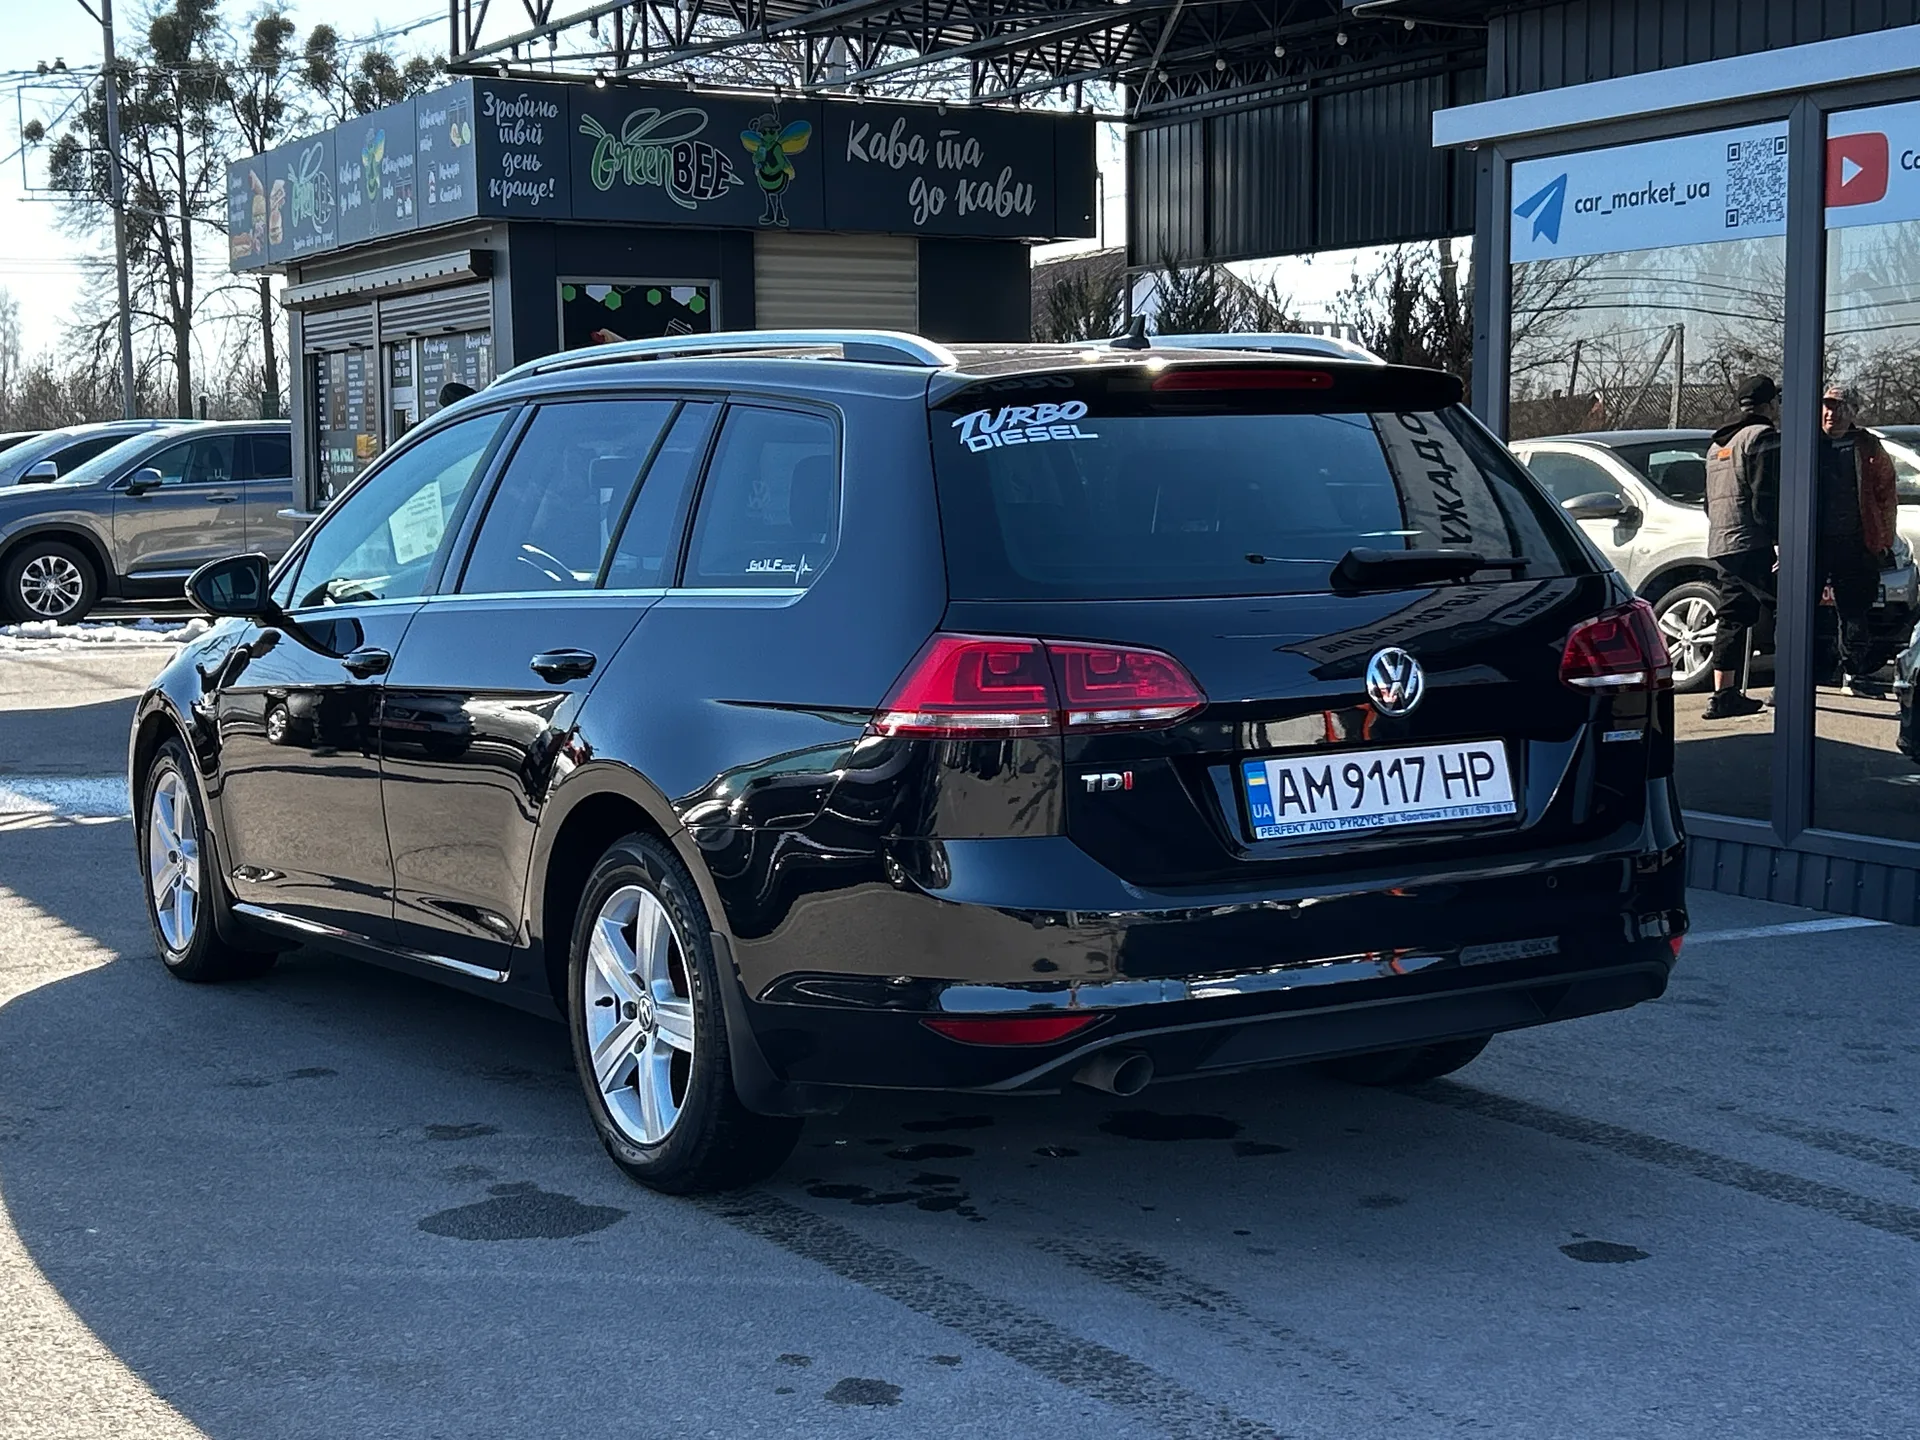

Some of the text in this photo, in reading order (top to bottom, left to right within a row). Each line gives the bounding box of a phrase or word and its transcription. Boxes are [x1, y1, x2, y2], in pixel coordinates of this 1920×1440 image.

[482, 91, 559, 126] Зробимо
[499, 118, 545, 146] твій
[846, 116, 985, 171] Кава та
[502, 151, 543, 178] день
[487, 177, 556, 207] краще!
[908, 165, 1037, 226] до кави
[1574, 180, 1711, 215] car_market_ua
[951, 400, 1088, 444] TURBO
[965, 424, 1099, 453] DIESEL
[1080, 770, 1133, 793] TDI
[1278, 750, 1495, 817] AM 9117 HP
[1252, 804, 1272, 818] UA
[1260, 823, 1306, 837] PERFEKT
[1308, 820, 1336, 832] AUTO
[1340, 815, 1385, 829] PYRZYCE
